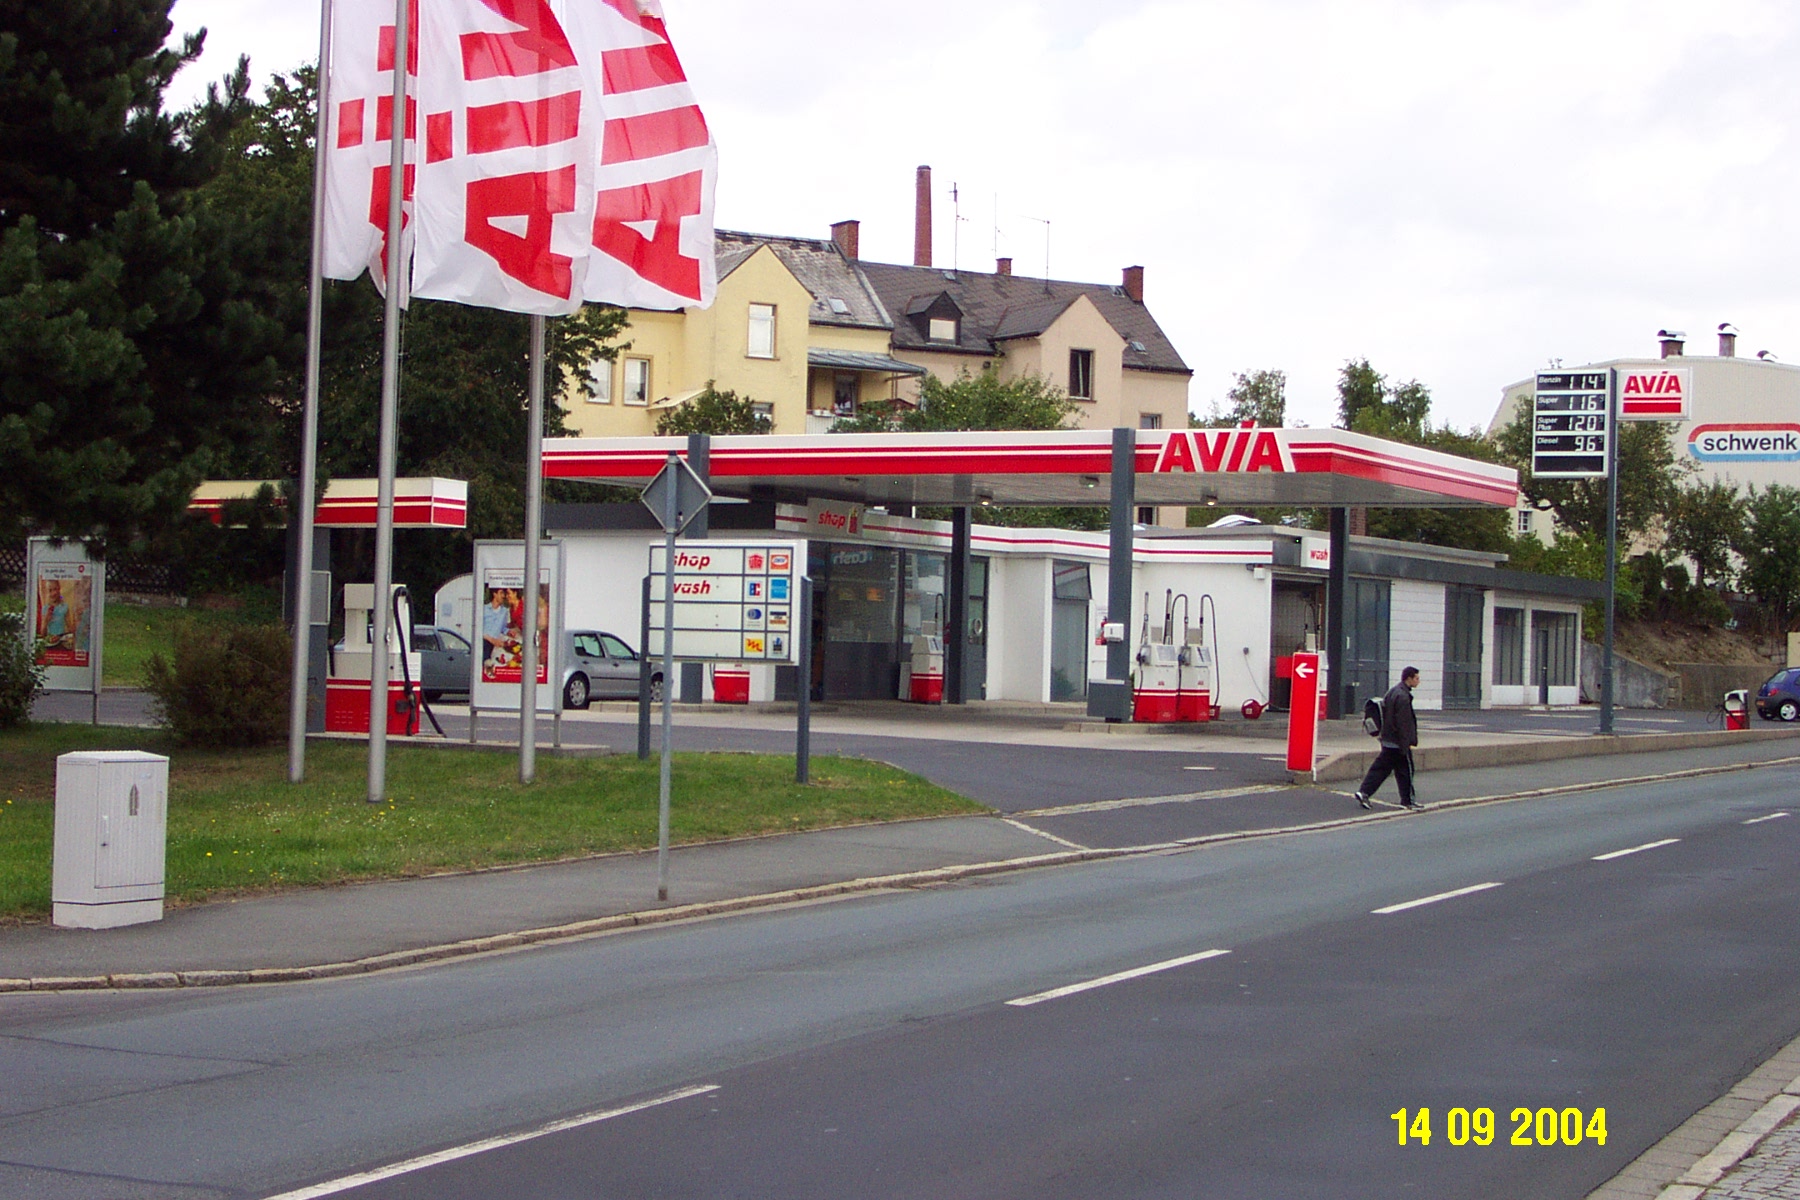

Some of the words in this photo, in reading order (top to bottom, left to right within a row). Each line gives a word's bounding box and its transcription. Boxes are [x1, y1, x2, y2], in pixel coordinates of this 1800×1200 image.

[1538, 376, 1562, 384] Benzin
[1569, 375, 1598, 390] 114
[1537, 396, 1559, 405] Super
[1569, 395, 1597, 411] 116
[1537, 416, 1558, 425] Super
[1568, 415, 1597, 431] 120
[1536, 436, 1559, 444] Diesel
[1574, 436, 1596, 452] 96
[1703, 433, 1798, 451] schwenk
[818, 510, 846, 529] shop
[1310, 548, 1329, 561] wash
